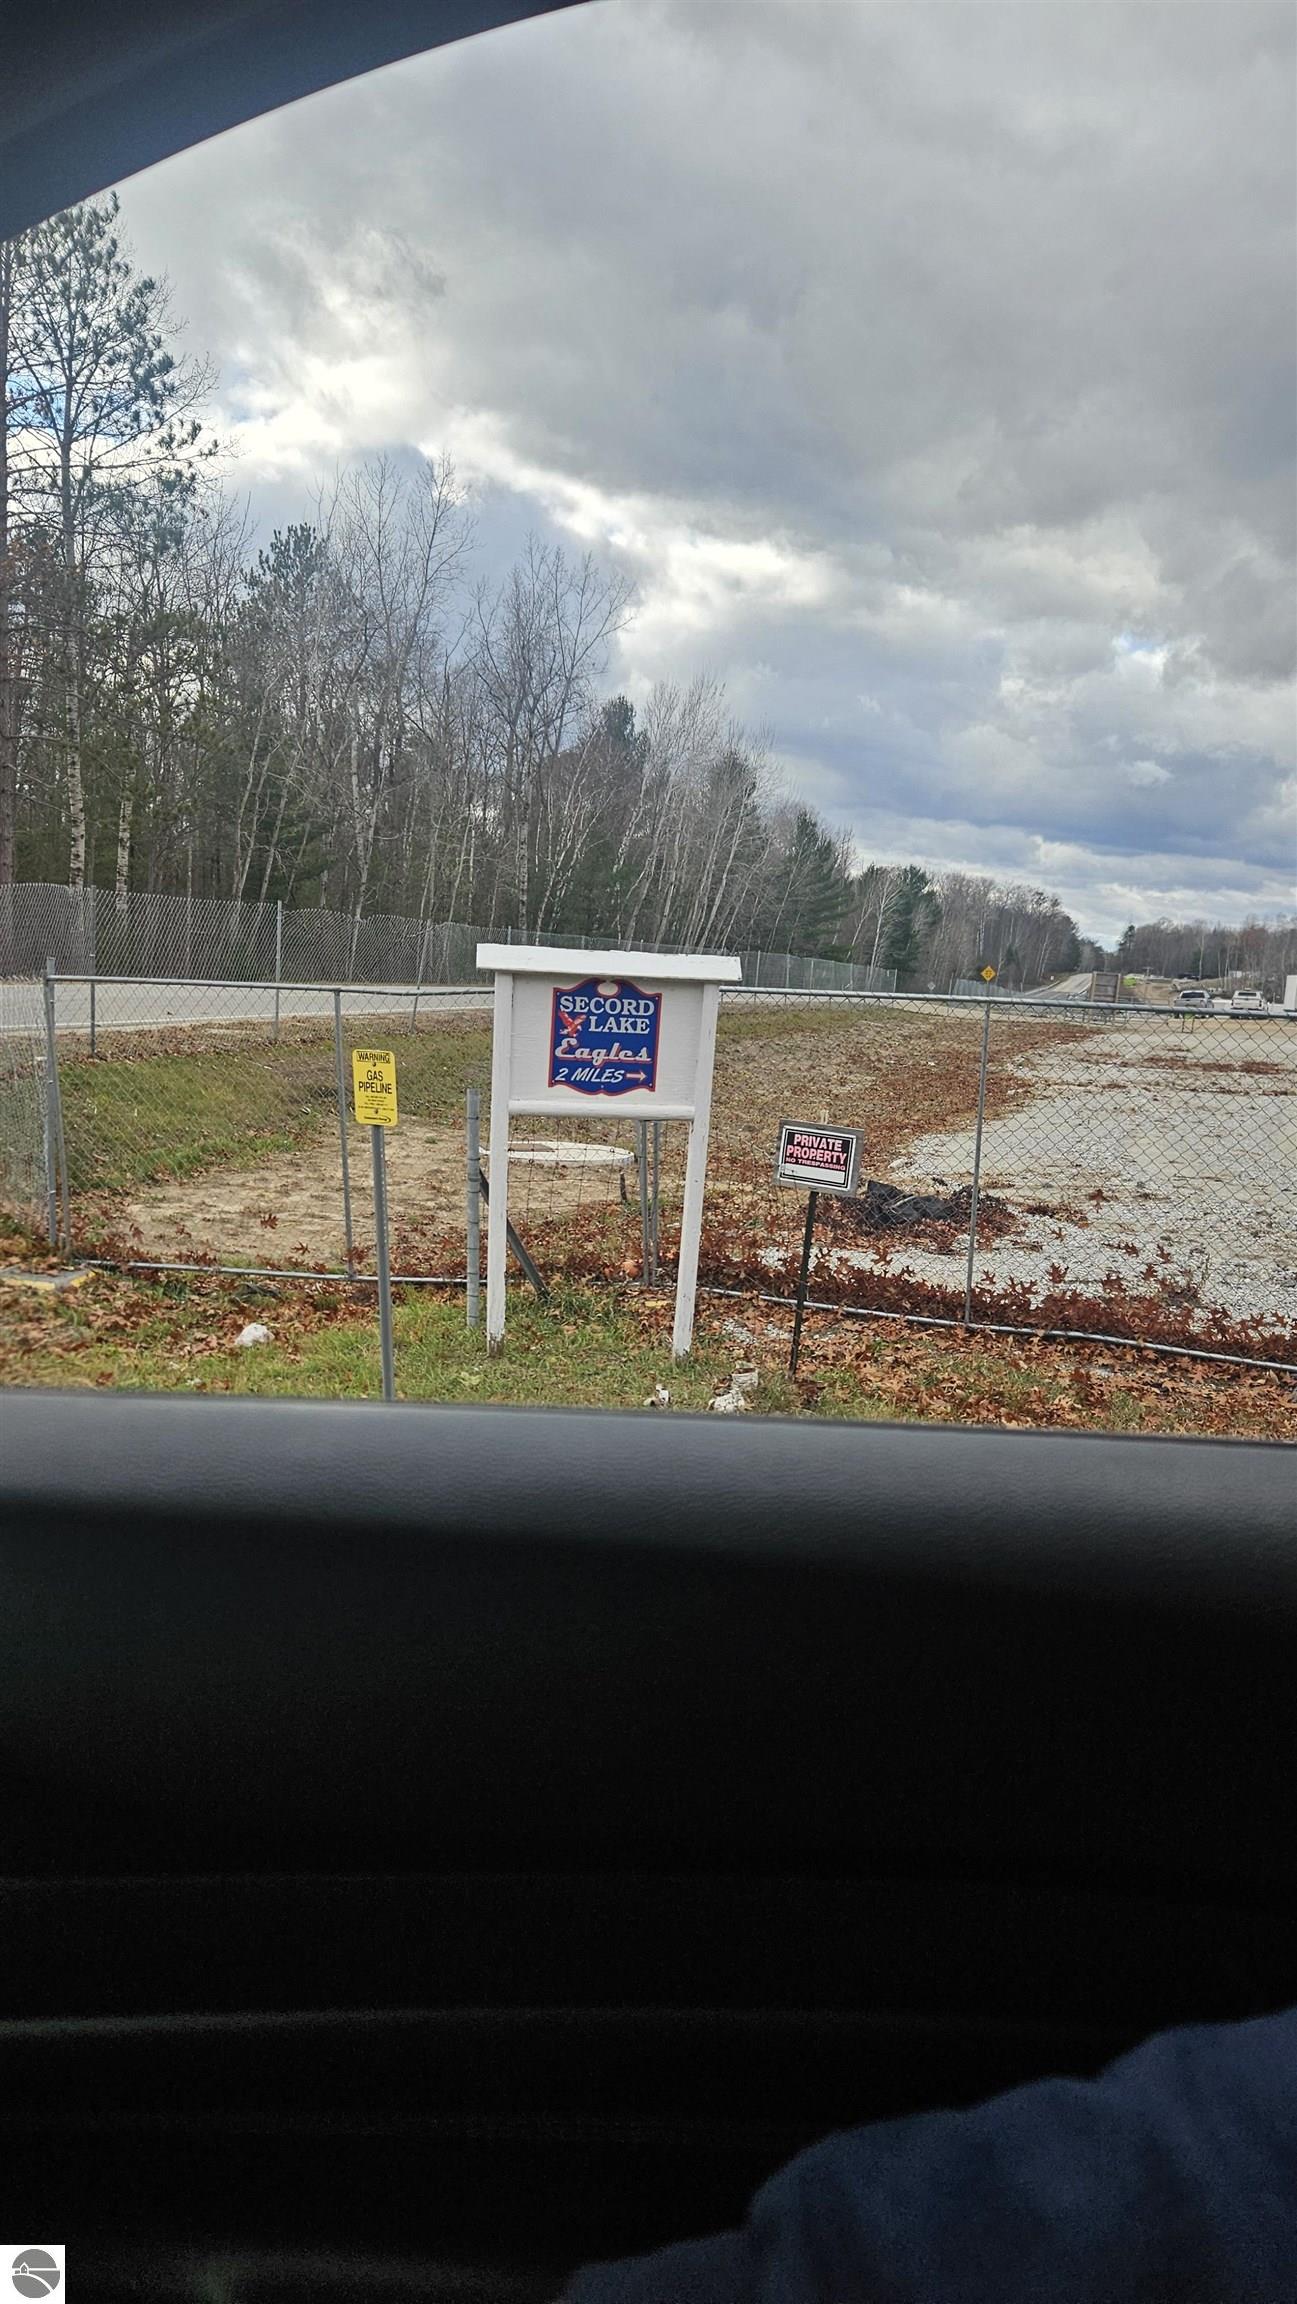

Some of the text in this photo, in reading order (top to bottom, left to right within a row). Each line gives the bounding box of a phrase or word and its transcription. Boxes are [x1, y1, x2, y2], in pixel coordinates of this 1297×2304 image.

[560, 995, 655, 1016] SECORD
[588, 1015, 650, 1034] LAKE
[358, 1052, 390, 1061] WARNING
[555, 1037, 652, 1066] Eagles
[366, 1070, 384, 1081] GAS
[555, 1067, 625, 1083] 2 MILES
[358, 1081, 392, 1094] PIPELINE
[793, 1134, 842, 1151] PRIVATE
[786, 1145, 847, 1164] PROPERTY
[798, 1158, 846, 1171] TRESPASSING
